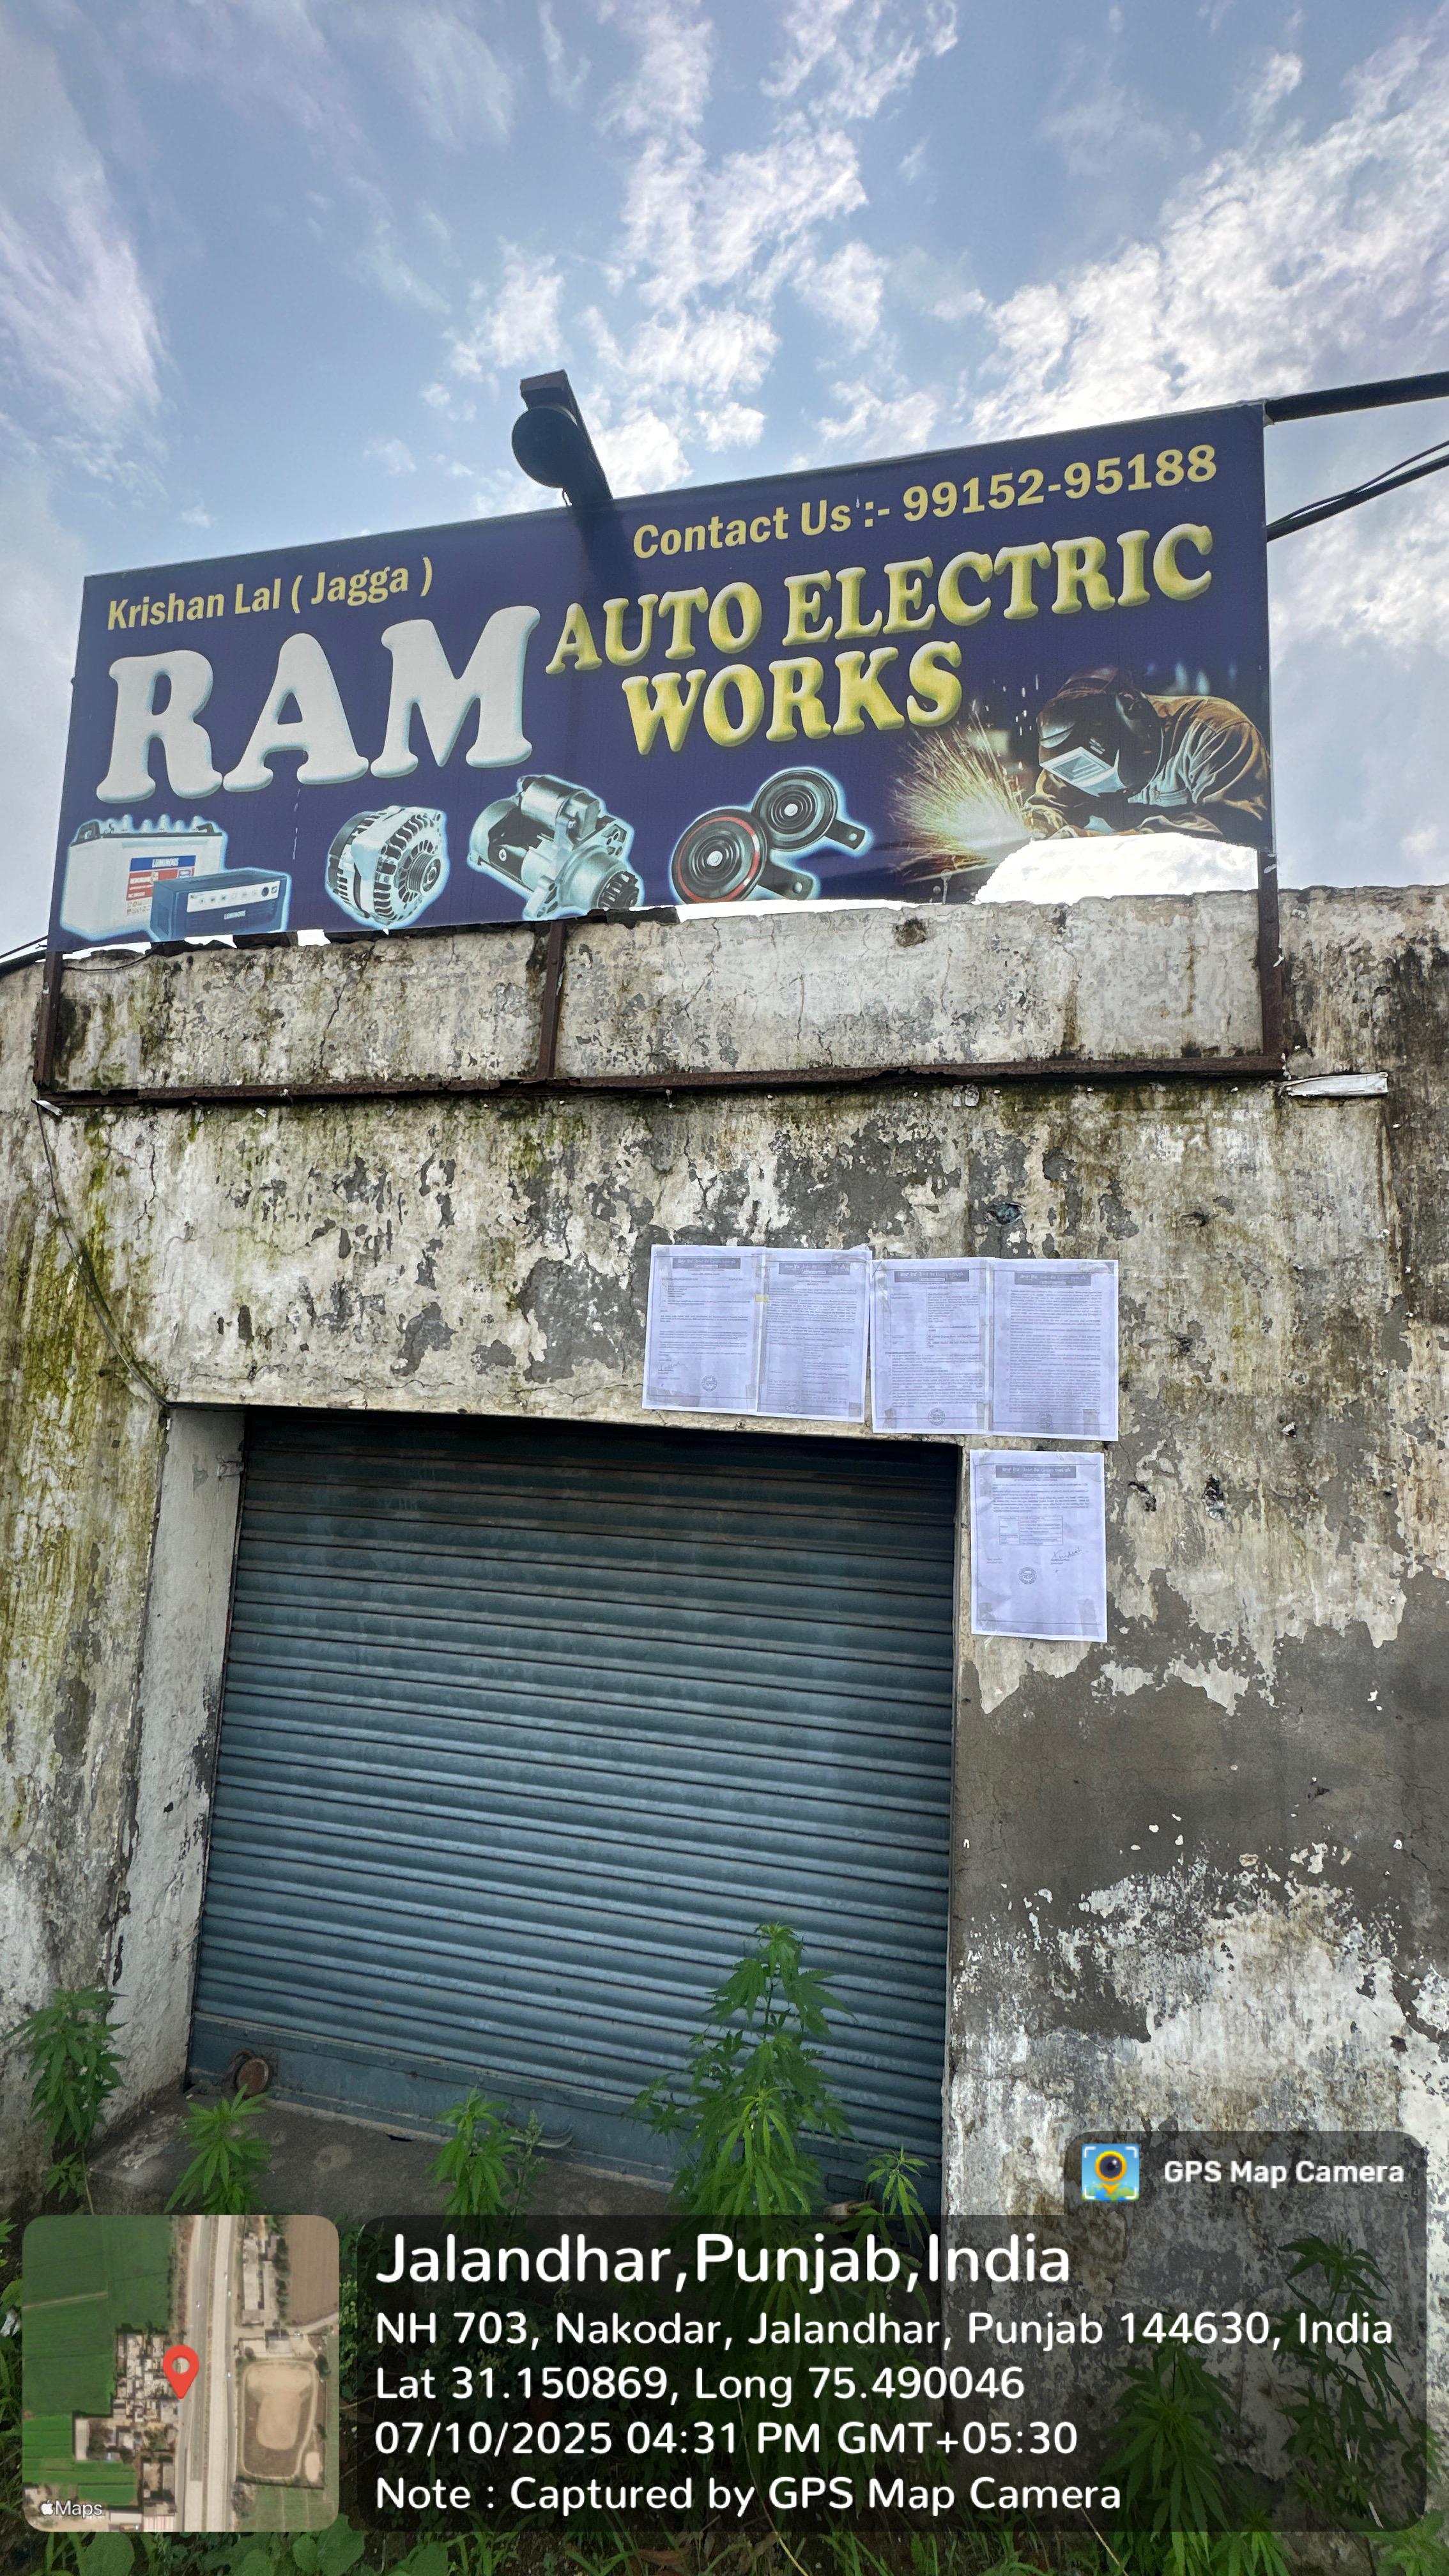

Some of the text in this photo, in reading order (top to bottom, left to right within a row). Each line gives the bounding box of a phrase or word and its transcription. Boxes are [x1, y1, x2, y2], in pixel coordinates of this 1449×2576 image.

[633, 507, 788, 558] Contact
[801, 500, 852, 535] Us
[903, 444, 1216, 522] 99152-95188
[108, 593, 224, 631] Krishan
[234, 576, 280, 614] Lal
[311, 565, 410, 607] Jagga
[546, 523, 1213, 674] AUTO ELECTRIC
[96, 605, 540, 804] RAM
[622, 641, 963, 755] WORKS
